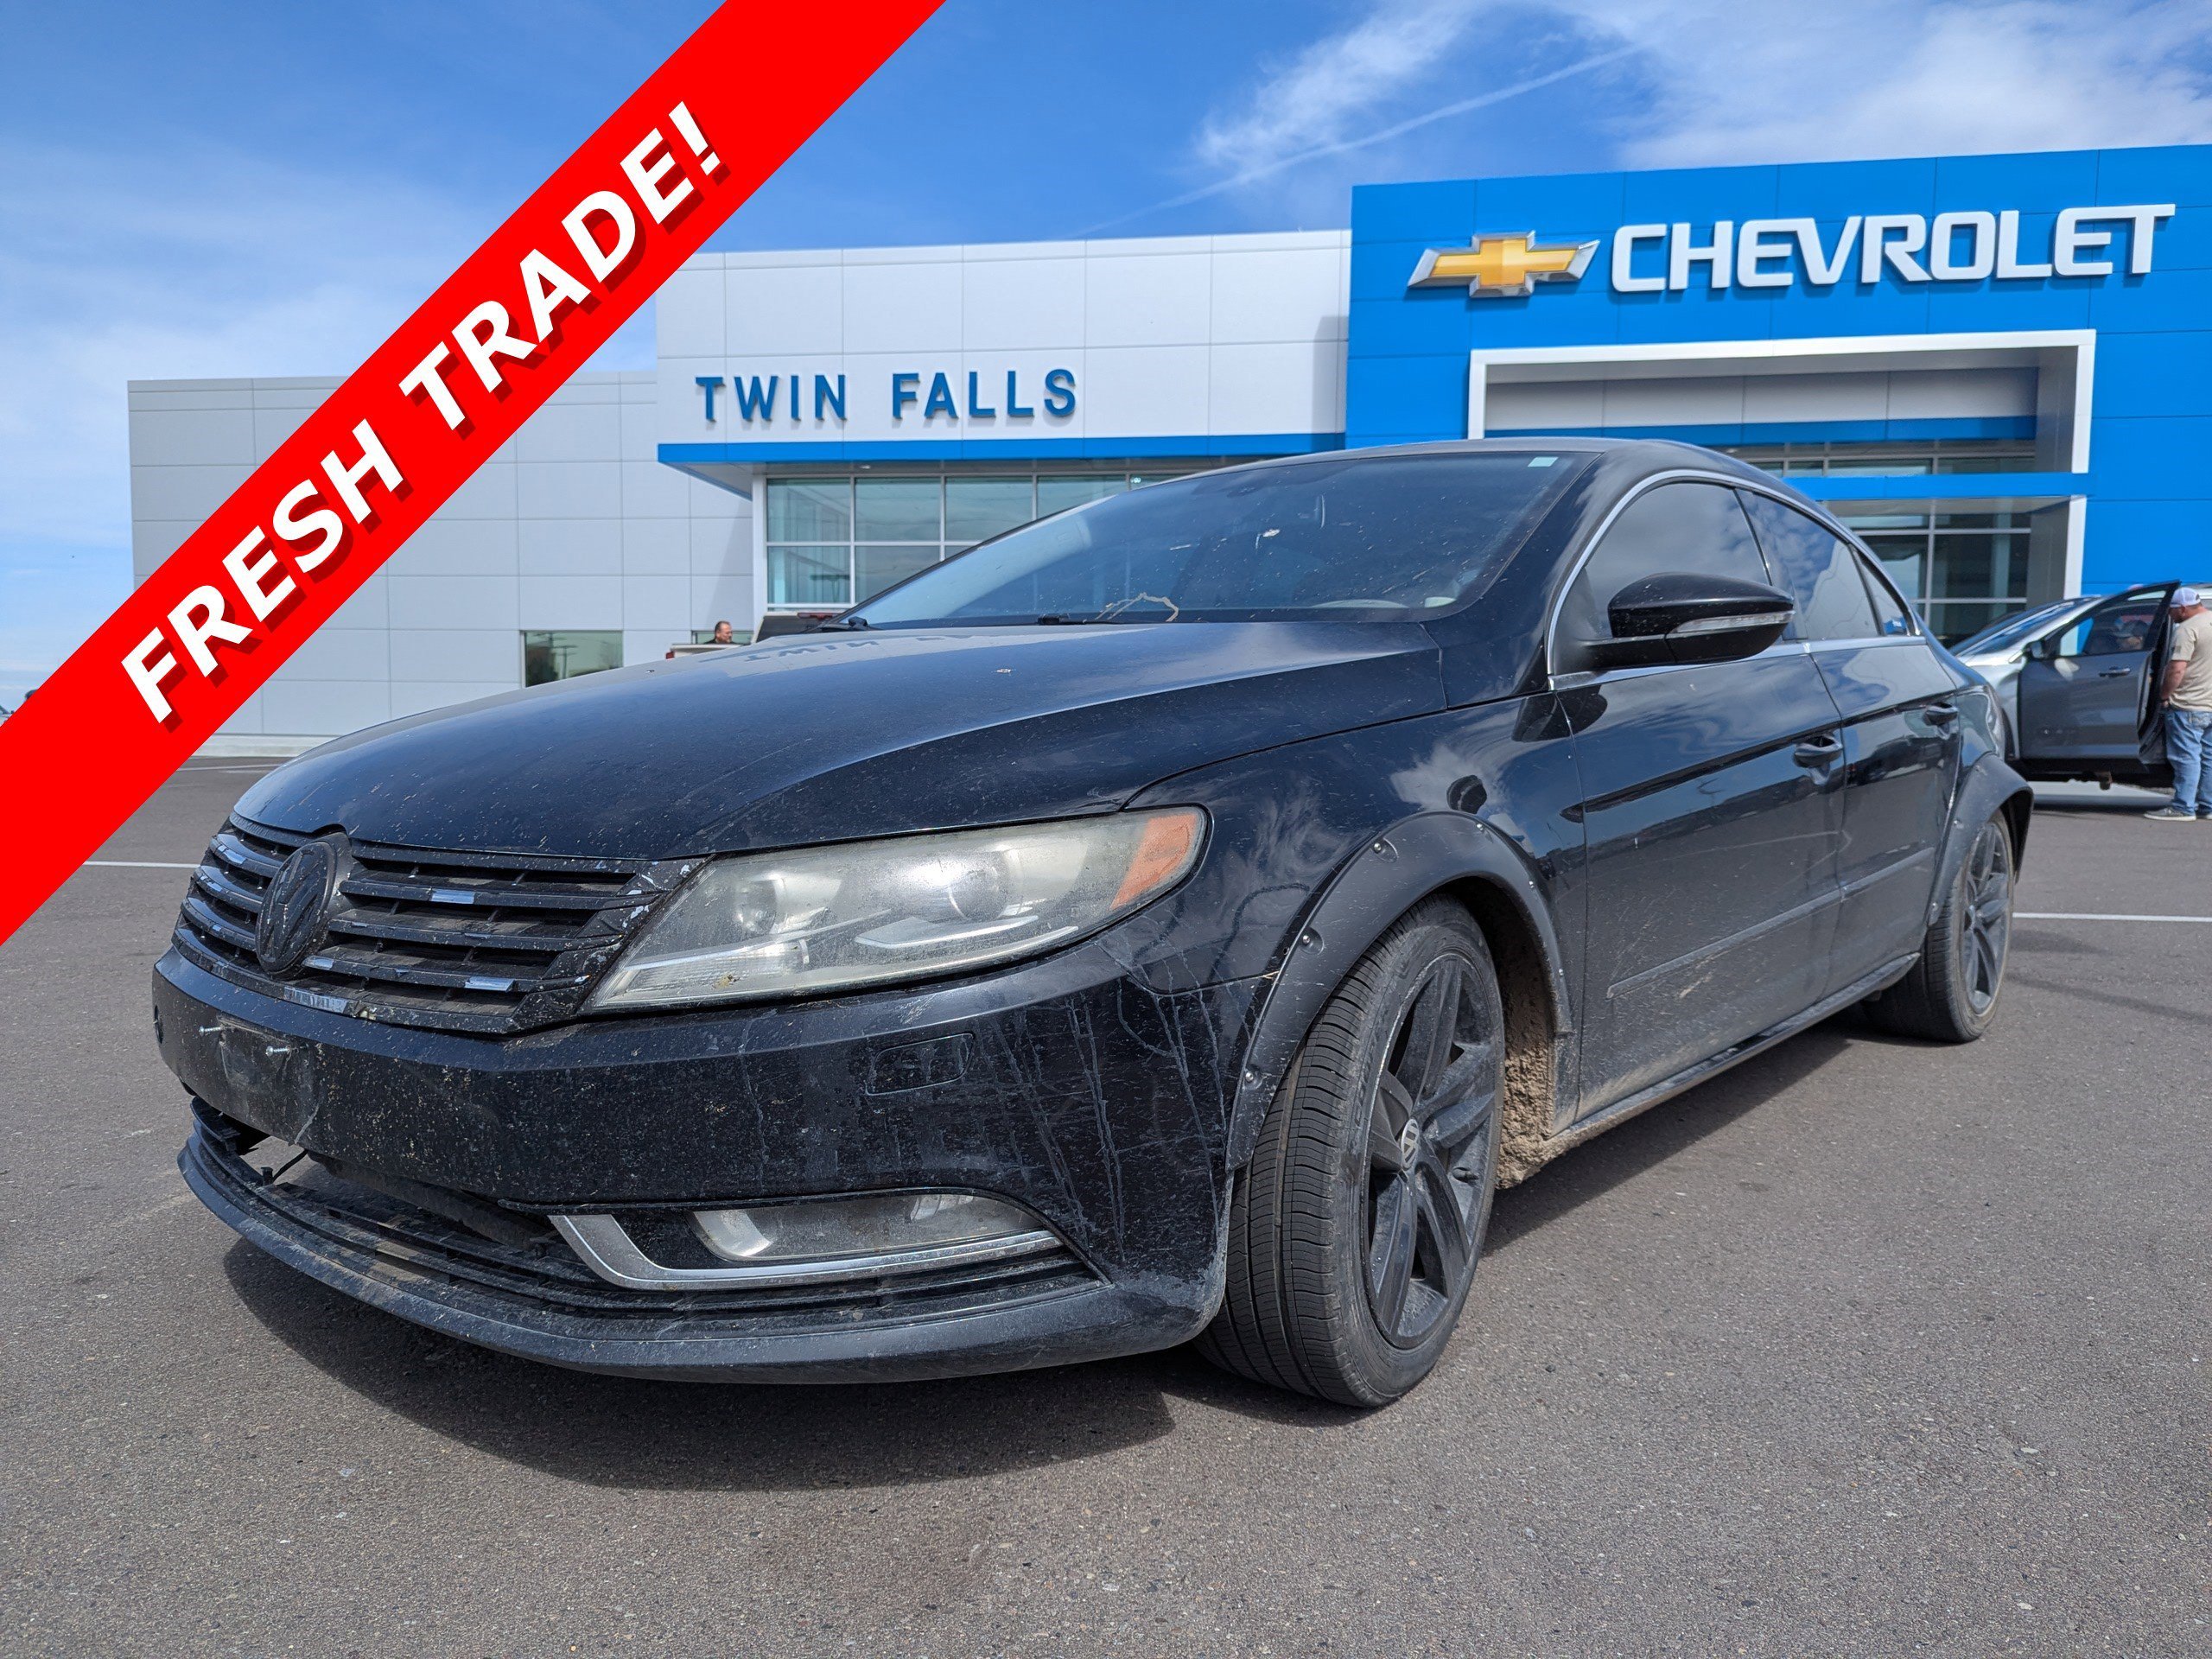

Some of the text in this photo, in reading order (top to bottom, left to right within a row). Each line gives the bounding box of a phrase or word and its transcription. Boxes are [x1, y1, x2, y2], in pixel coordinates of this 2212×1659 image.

[1611, 203, 2176, 292] CHEVROLET
[695, 368, 1077, 422] TWIN FALLS
